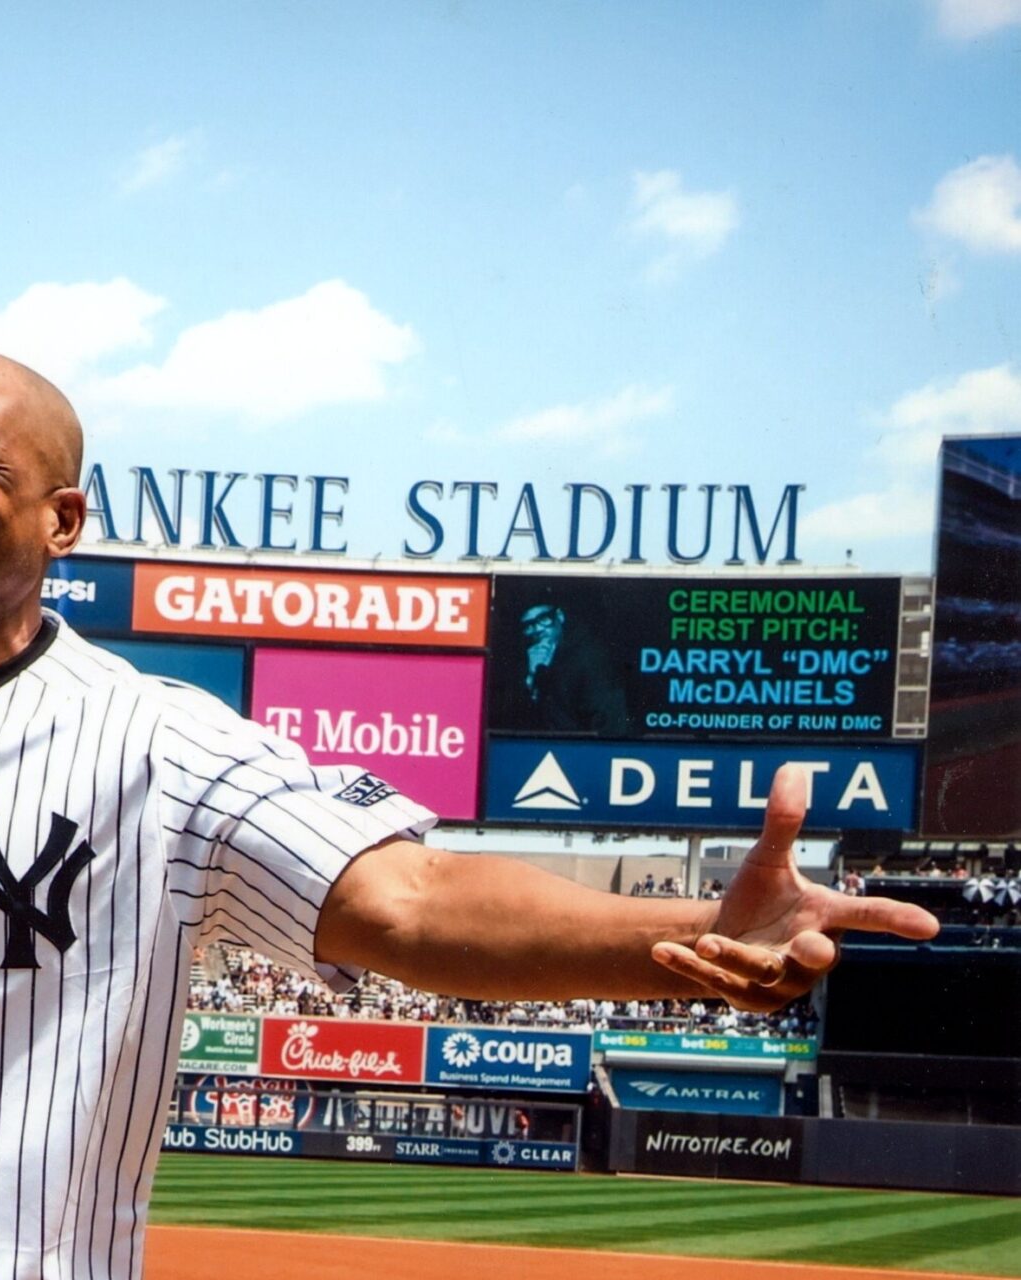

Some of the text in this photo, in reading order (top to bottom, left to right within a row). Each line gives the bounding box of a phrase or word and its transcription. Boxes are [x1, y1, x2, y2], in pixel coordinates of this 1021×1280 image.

[84, 462, 806, 566] ANKEE STADIUM
[41, 577, 96, 602] EPSI
[154, 576, 469, 632] GATORADE
[668, 590, 865, 614] CEREMONIAL
[670, 618, 859, 641] FIRST PITCH:
[640, 648, 772, 674] DARRYL
[668, 678, 856, 705] McDANIELS
[645, 713, 883, 731] CO-FOUNDER OF RUN DMC
[609, 757, 889, 811] DELTA
[600, 1033, 647, 1046] bet365
[681, 1036, 728, 1050] bet365
[482, 1039, 573, 1072] coupa
[439, 1070, 572, 1088] Business Spend Management
[665, 1086, 761, 1101] AMTRAK
[204, 1128, 294, 1152] StubHub
[395, 1141, 441, 1157] STARR
[646, 1130, 792, 1160] NITTOTIRE.COM
[520, 1147, 572, 1162] CLEAR
